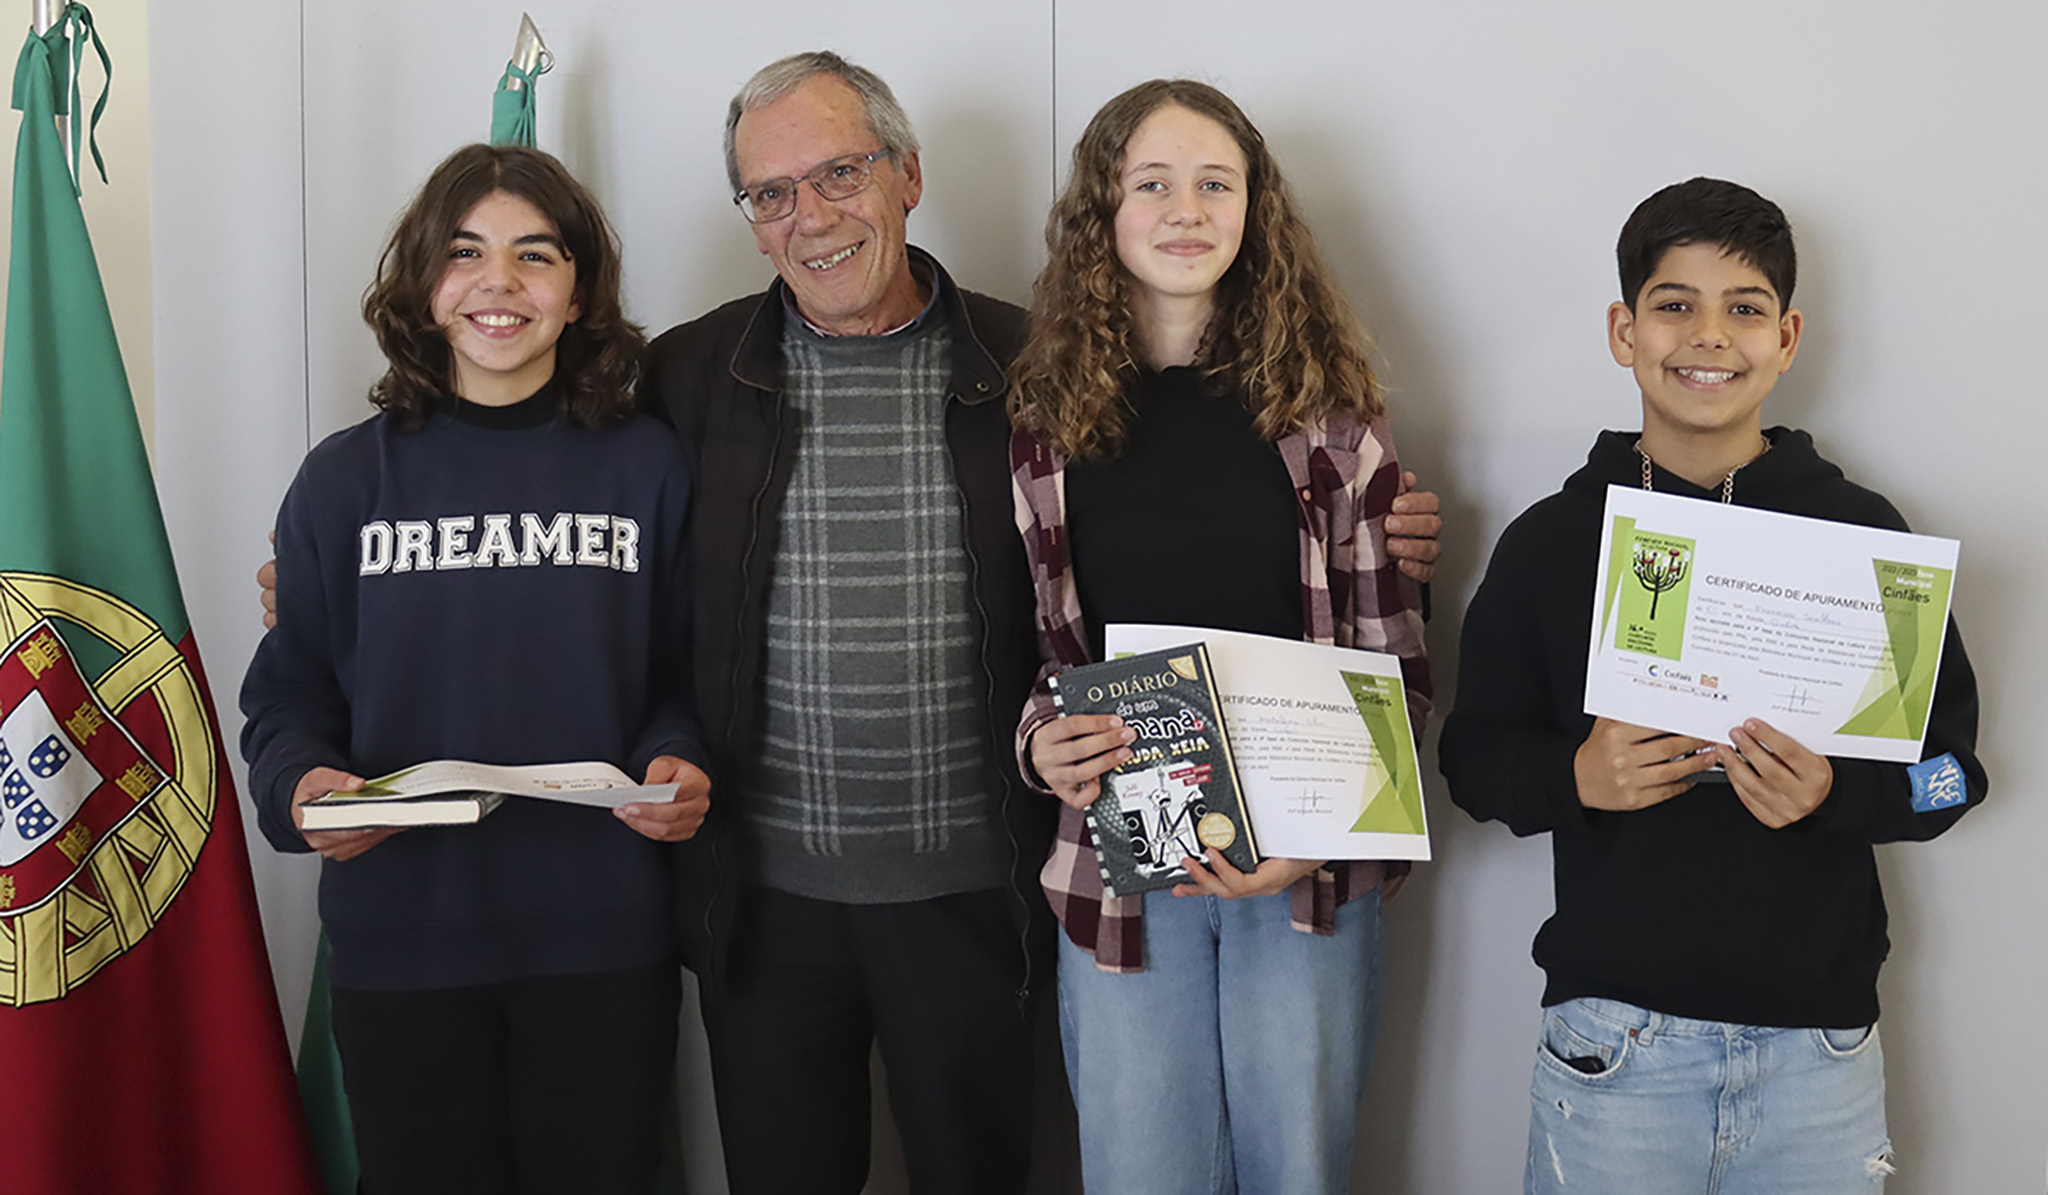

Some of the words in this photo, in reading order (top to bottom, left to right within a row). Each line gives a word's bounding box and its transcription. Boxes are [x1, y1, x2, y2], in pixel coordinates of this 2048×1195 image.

[359, 513, 640, 576] DREAMER
[1705, 574, 1783, 598] CERTIFICADO
[1784, 588, 1800, 601] DE
[1802, 592, 1885, 614] APURAMENTO
[1883, 586, 1930, 603] Cinfães
[1087, 686, 1103, 702] O
[1108, 671, 1178, 699] DIÁRIO
[1222, 695, 1278, 707] RTIFICADO
[1280, 698, 1294, 708] DE
[1295, 700, 1362, 716] APURAMENTO
[1125, 709, 1197, 739] nana
[1169, 736, 1210, 756] XEIA
